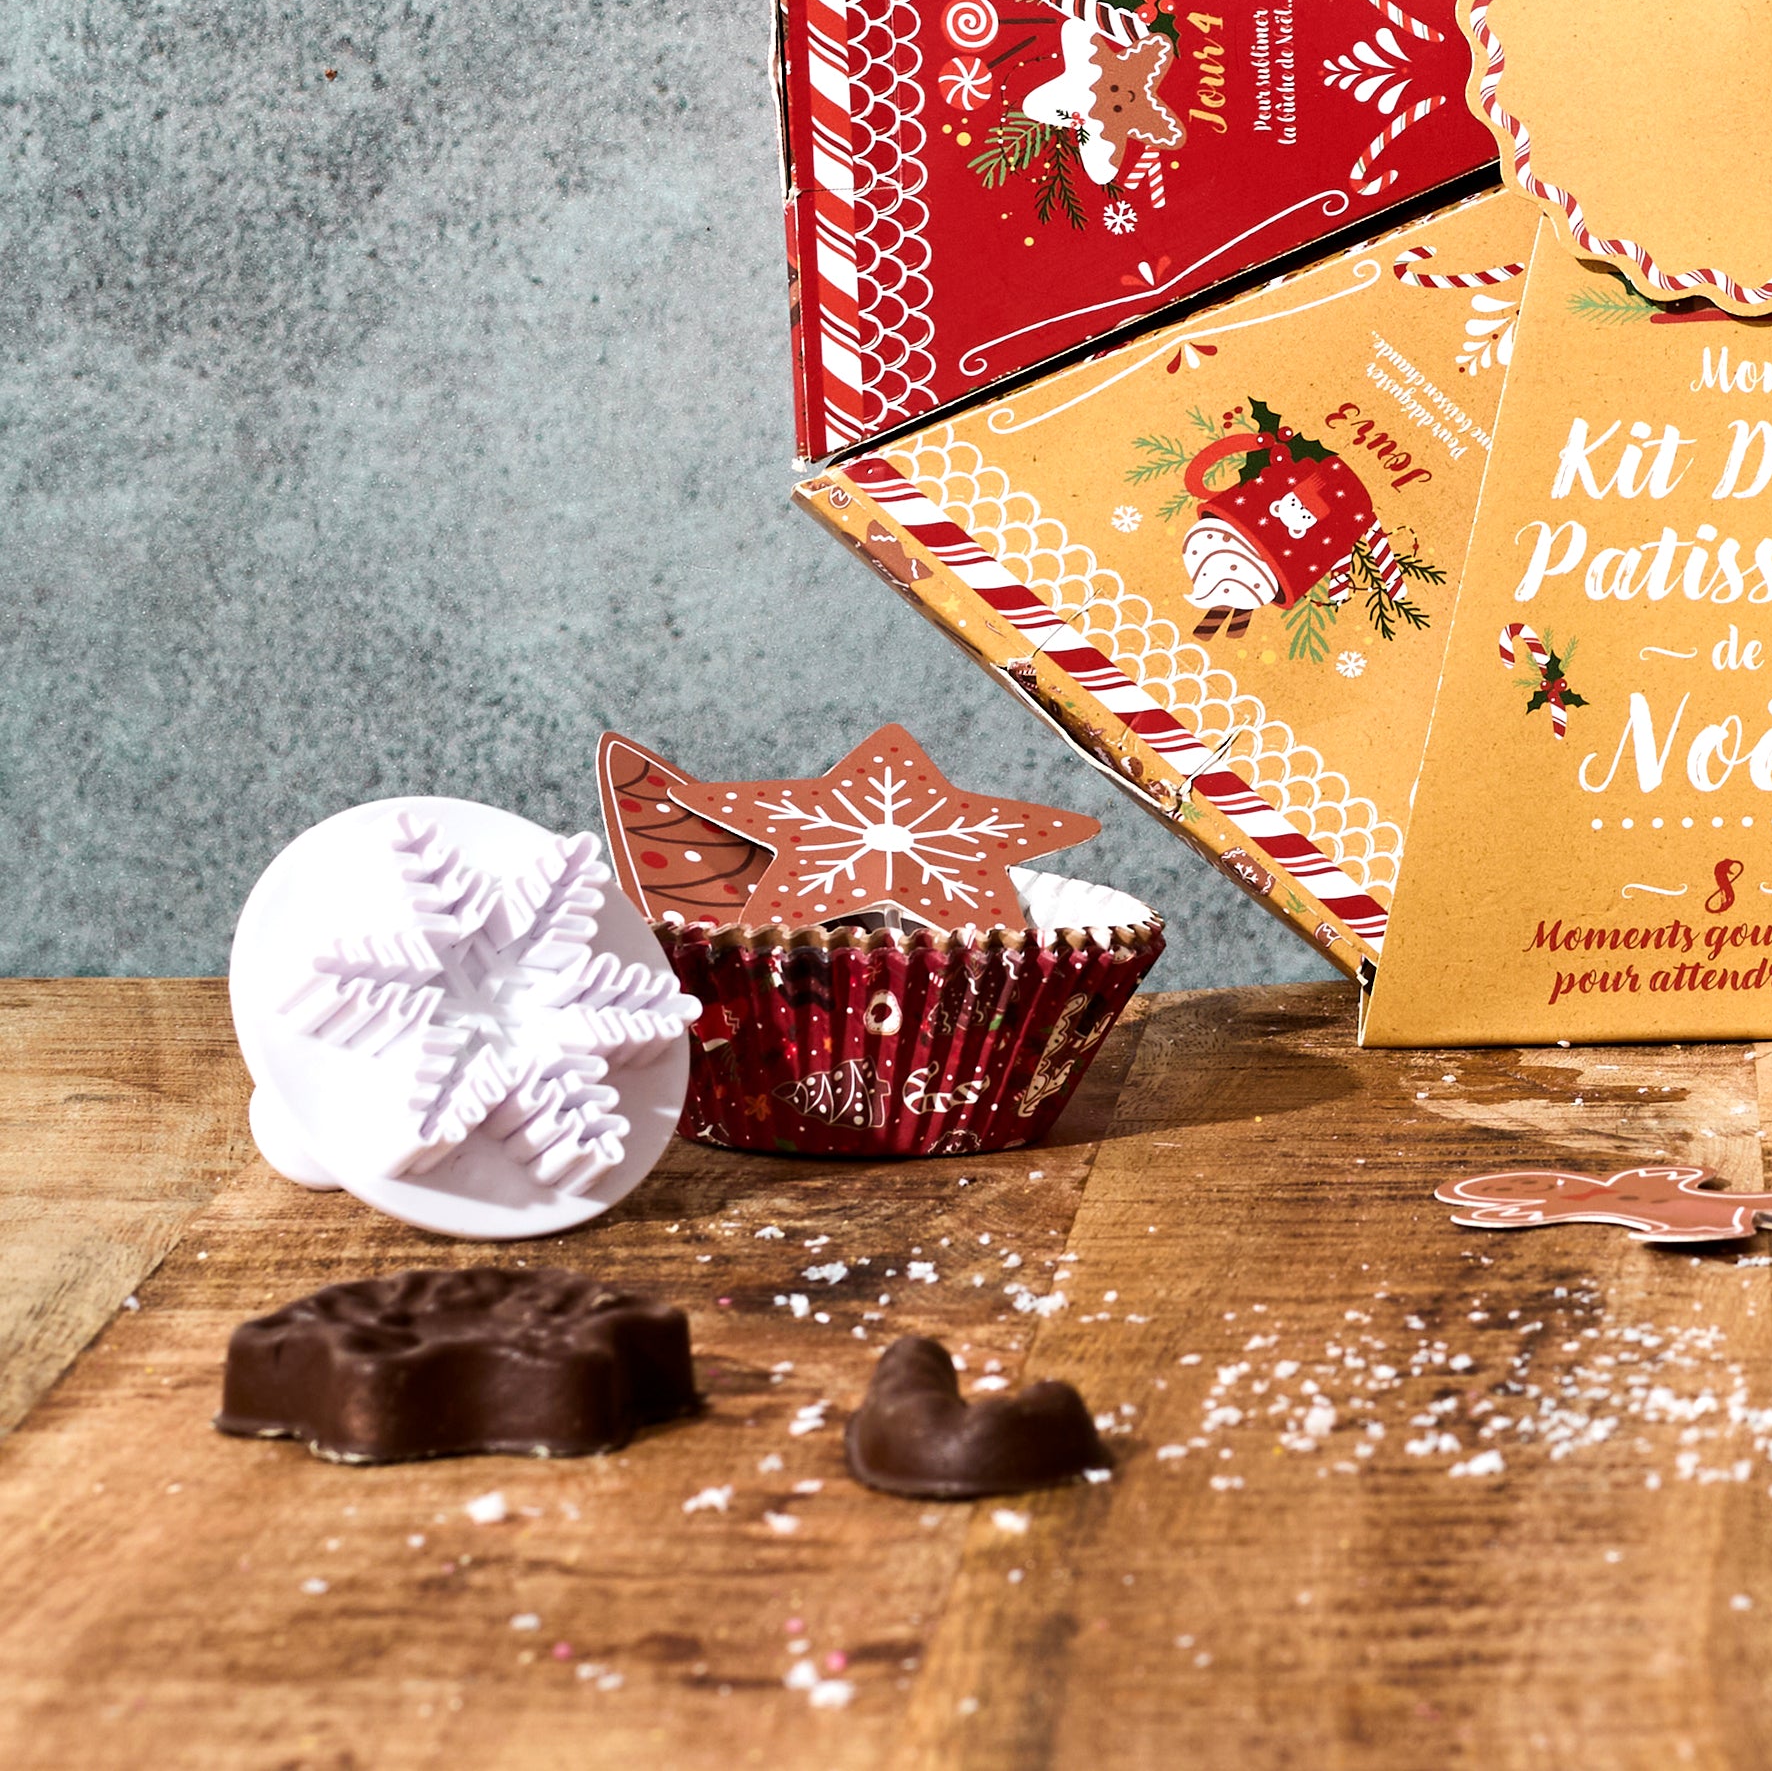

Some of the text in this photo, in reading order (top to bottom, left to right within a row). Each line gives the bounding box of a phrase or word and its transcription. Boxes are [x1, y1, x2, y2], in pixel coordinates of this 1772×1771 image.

[1187, 12, 1228, 133] Jour 4
[1250, 8, 1272, 130] Pour sublimer
[1275, 47, 1294, 68] de
[1275, 72, 1296, 122] bûche
[1277, 126, 1296, 144] la
[1366, 362, 1468, 460] Pour ddéguster
[1423, 383, 1472, 433] boisson
[1325, 403, 1432, 493] Jour 3
[1551, 417, 1697, 502] Kit
[1711, 624, 1765, 671] de
[1705, 859, 1744, 914] 8
[1523, 919, 1702, 953] Moments
[1548, 965, 1643, 1005] pour
